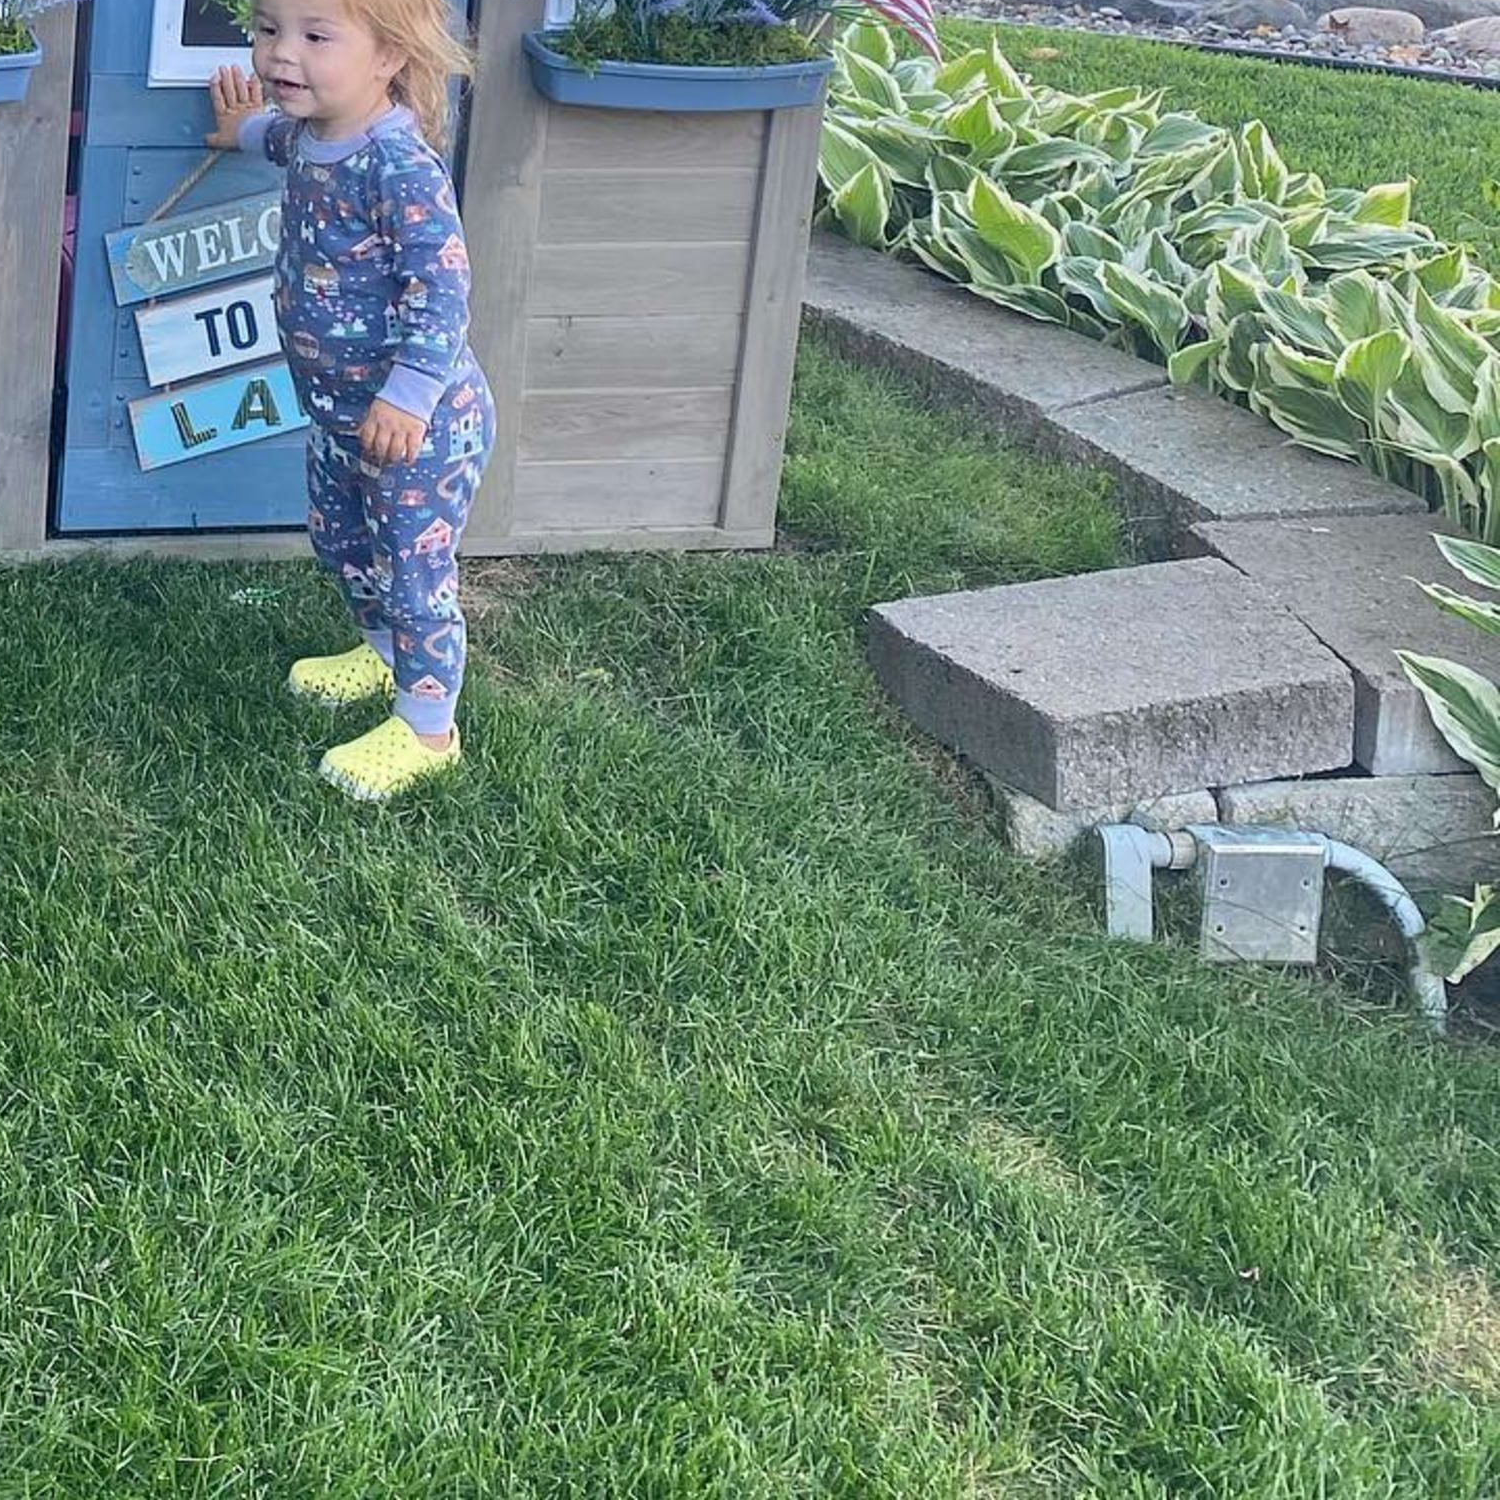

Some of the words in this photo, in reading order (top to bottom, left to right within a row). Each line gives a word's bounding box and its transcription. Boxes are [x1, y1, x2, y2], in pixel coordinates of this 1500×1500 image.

[144, 206, 282, 282] WELC
[195, 301, 258, 357] TO
[170, 377, 282, 449] LA
